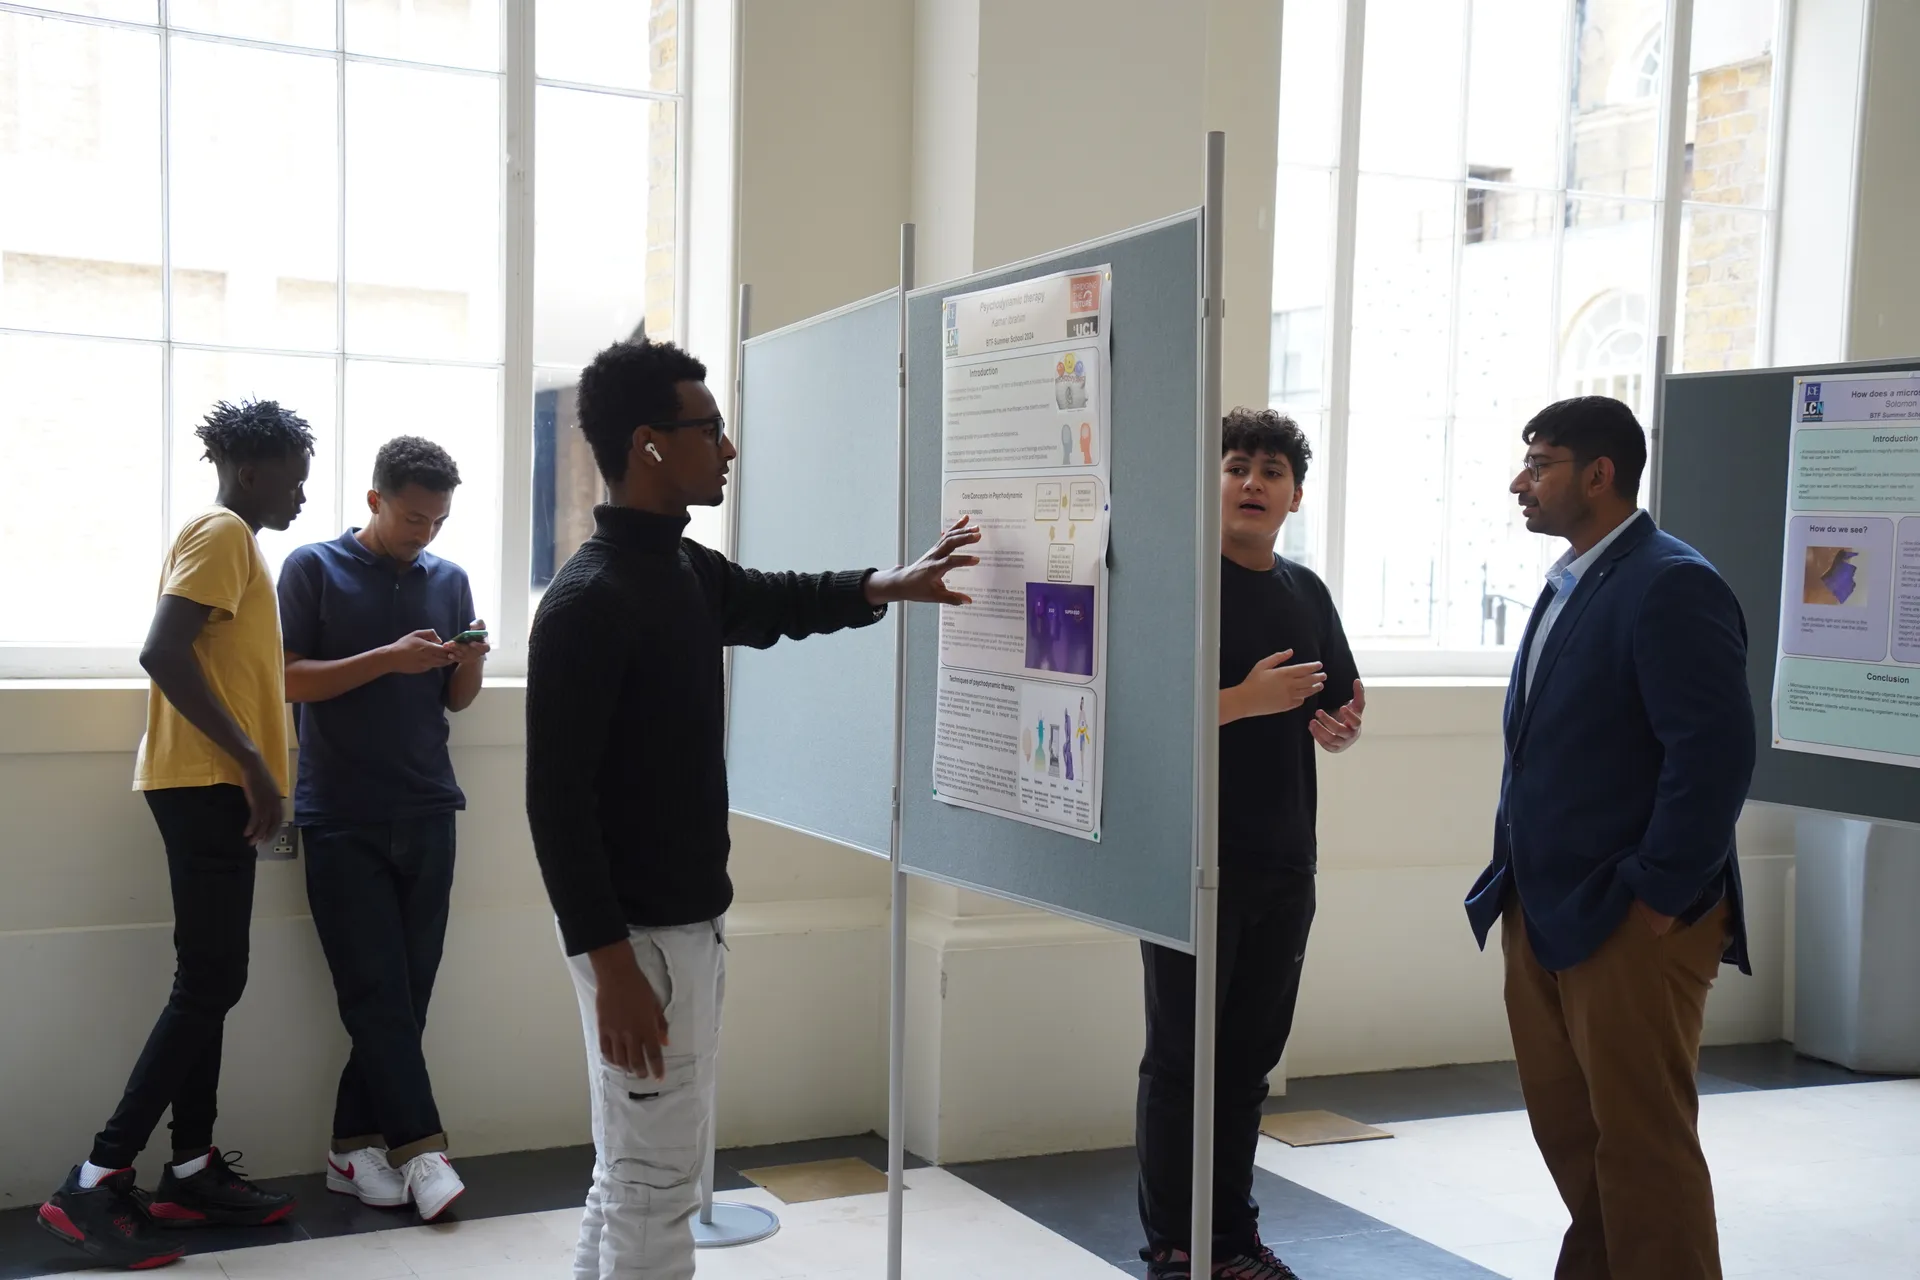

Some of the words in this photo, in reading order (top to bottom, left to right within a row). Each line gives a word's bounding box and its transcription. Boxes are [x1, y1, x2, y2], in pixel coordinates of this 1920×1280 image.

[1024, 292, 1046, 304] therapy
[1076, 322, 1096, 337] UCL
[994, 336, 1010, 346] Summer
[1010, 332, 1024, 343] School
[970, 367, 998, 378] Introduction
[1803, 402, 1824, 415] LCN
[1872, 434, 1918, 442] Introduction
[993, 492, 1023, 500] Psychodynamic
[949, 674, 968, 684] Techniques
[973, 679, 1000, 689] psychodynamic
[1867, 672, 1910, 684] Conclusion
